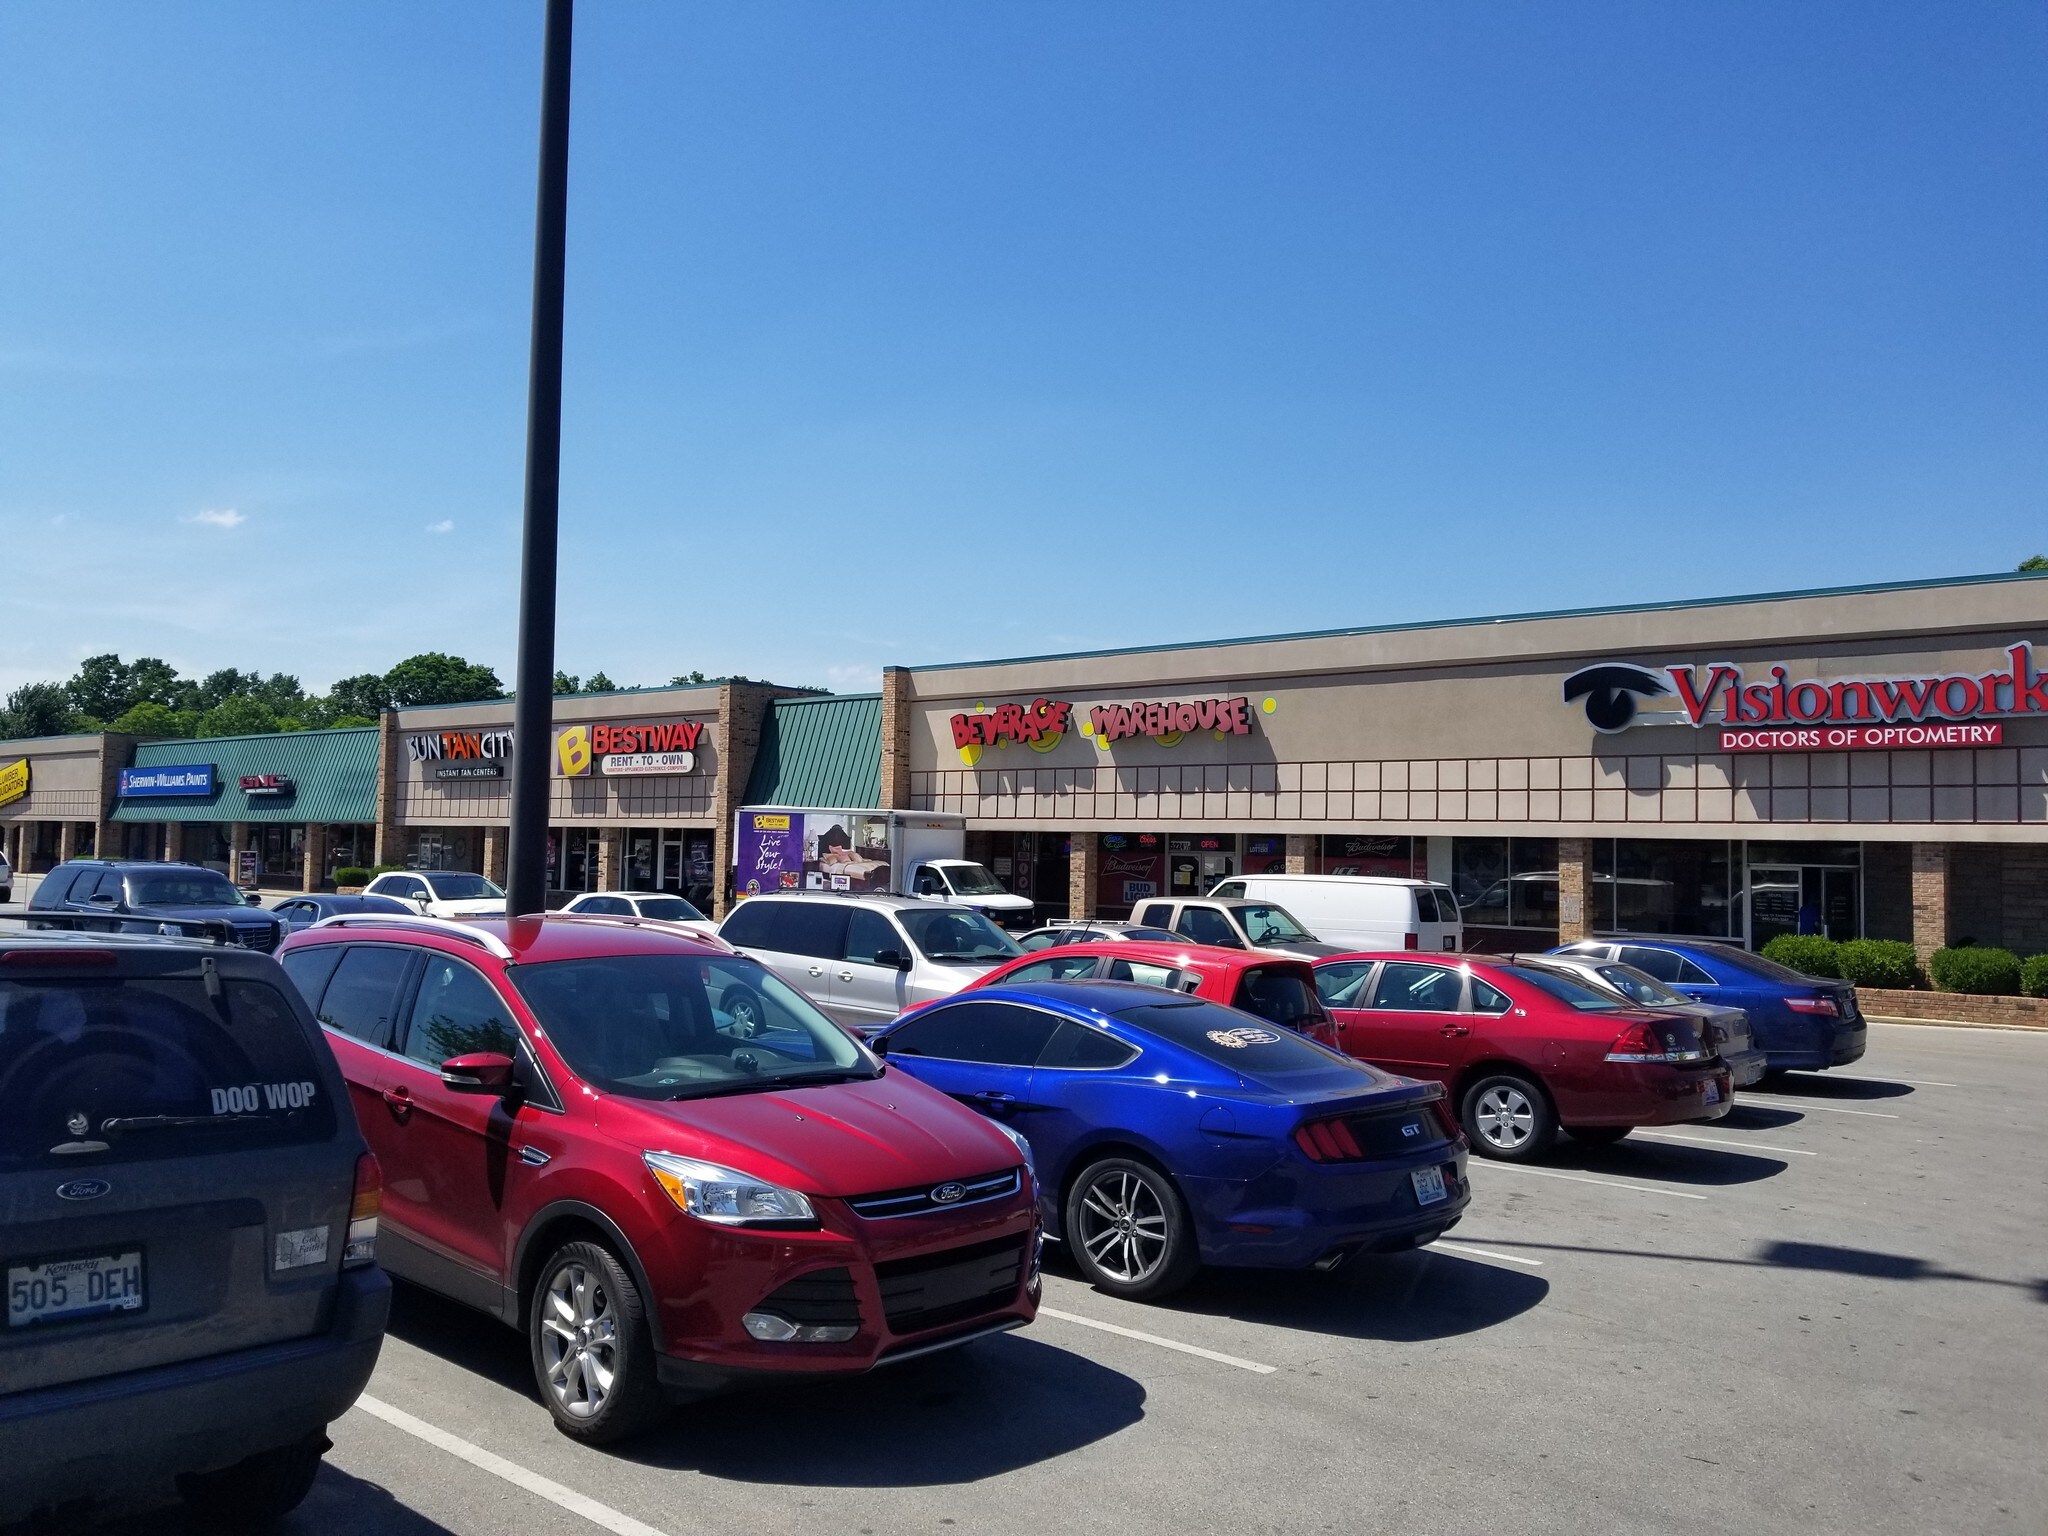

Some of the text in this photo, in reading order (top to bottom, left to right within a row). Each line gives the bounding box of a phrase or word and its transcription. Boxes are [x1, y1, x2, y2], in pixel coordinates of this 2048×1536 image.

[950, 697, 1248, 749] BEVERAGE WAREHOUSE
[593, 721, 702, 753] BESTWAY
[1723, 725, 1997, 748] DOCTORS OF OPTOMETRY
[611, 755, 683, 767] RENT TO OWN
[0, 768, 18, 786] UMBER
[186, 772, 207, 786] PAINTS
[437, 769, 459, 777] INSTANT
[473, 768, 497, 776] CENTERS
[240, 775, 285, 787] GNC
[760, 834, 781, 846] Live
[1200, 840, 1218, 848] OPEN
[1345, 842, 1396, 852] Budweiser
[759, 845, 781, 860] Your
[755, 858, 783, 874] Style!
[1104, 859, 1151, 871] Budweiser
[1332, 867, 1359, 876] ICE
[1129, 883, 1151, 892] BUD
[211, 1081, 315, 1115] DOO WOP
[1401, 1123, 1420, 1137] GT
[44, 1259, 99, 1276] Kentucky
[11, 1265, 140, 1312] 505 DEH
